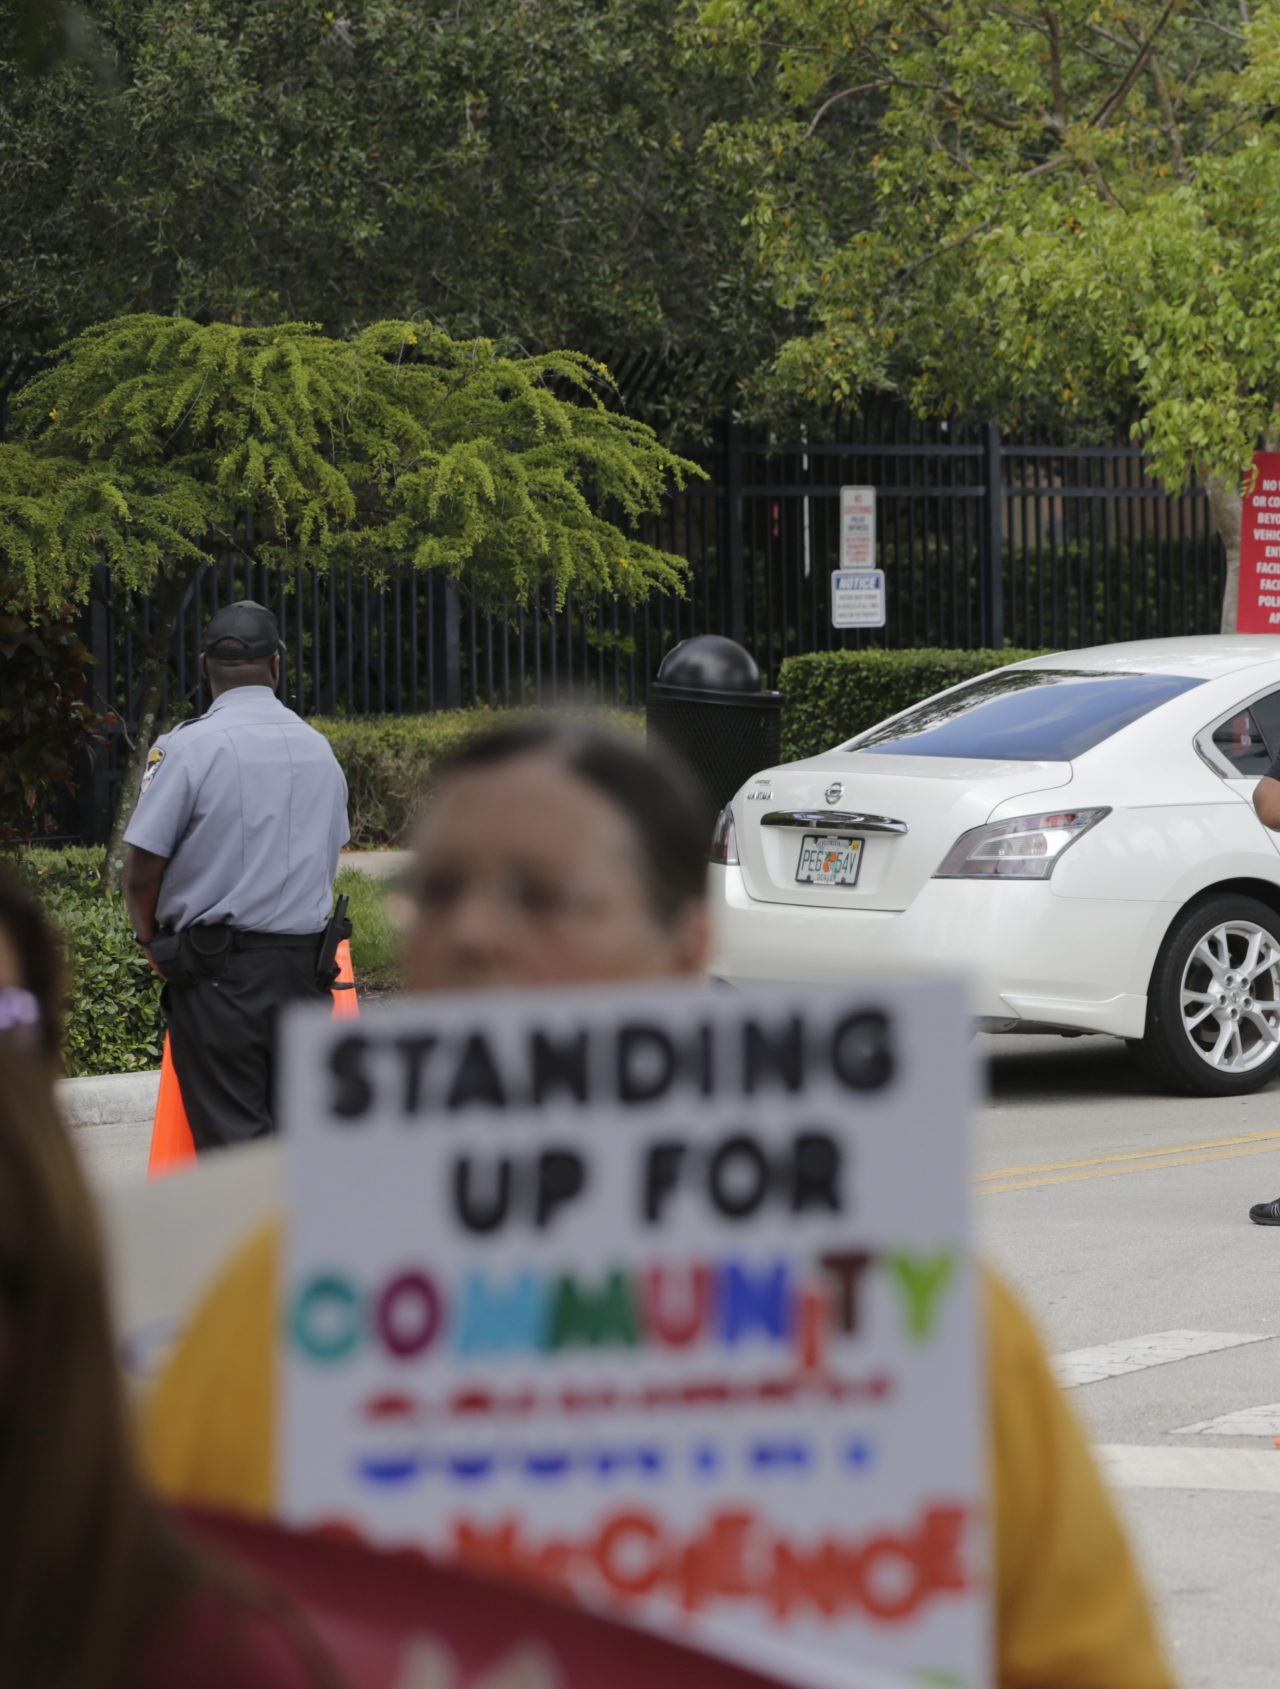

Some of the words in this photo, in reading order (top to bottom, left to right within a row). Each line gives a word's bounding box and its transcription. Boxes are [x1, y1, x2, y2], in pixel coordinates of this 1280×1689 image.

[1252, 496, 1267, 508] OR
[1262, 480, 1278, 491] NO
[326, 1008, 899, 1121] STANDING
[450, 1146, 590, 1234] UP
[640, 1131, 848, 1226] FOR
[290, 1249, 957, 1372] COMMUNITY
